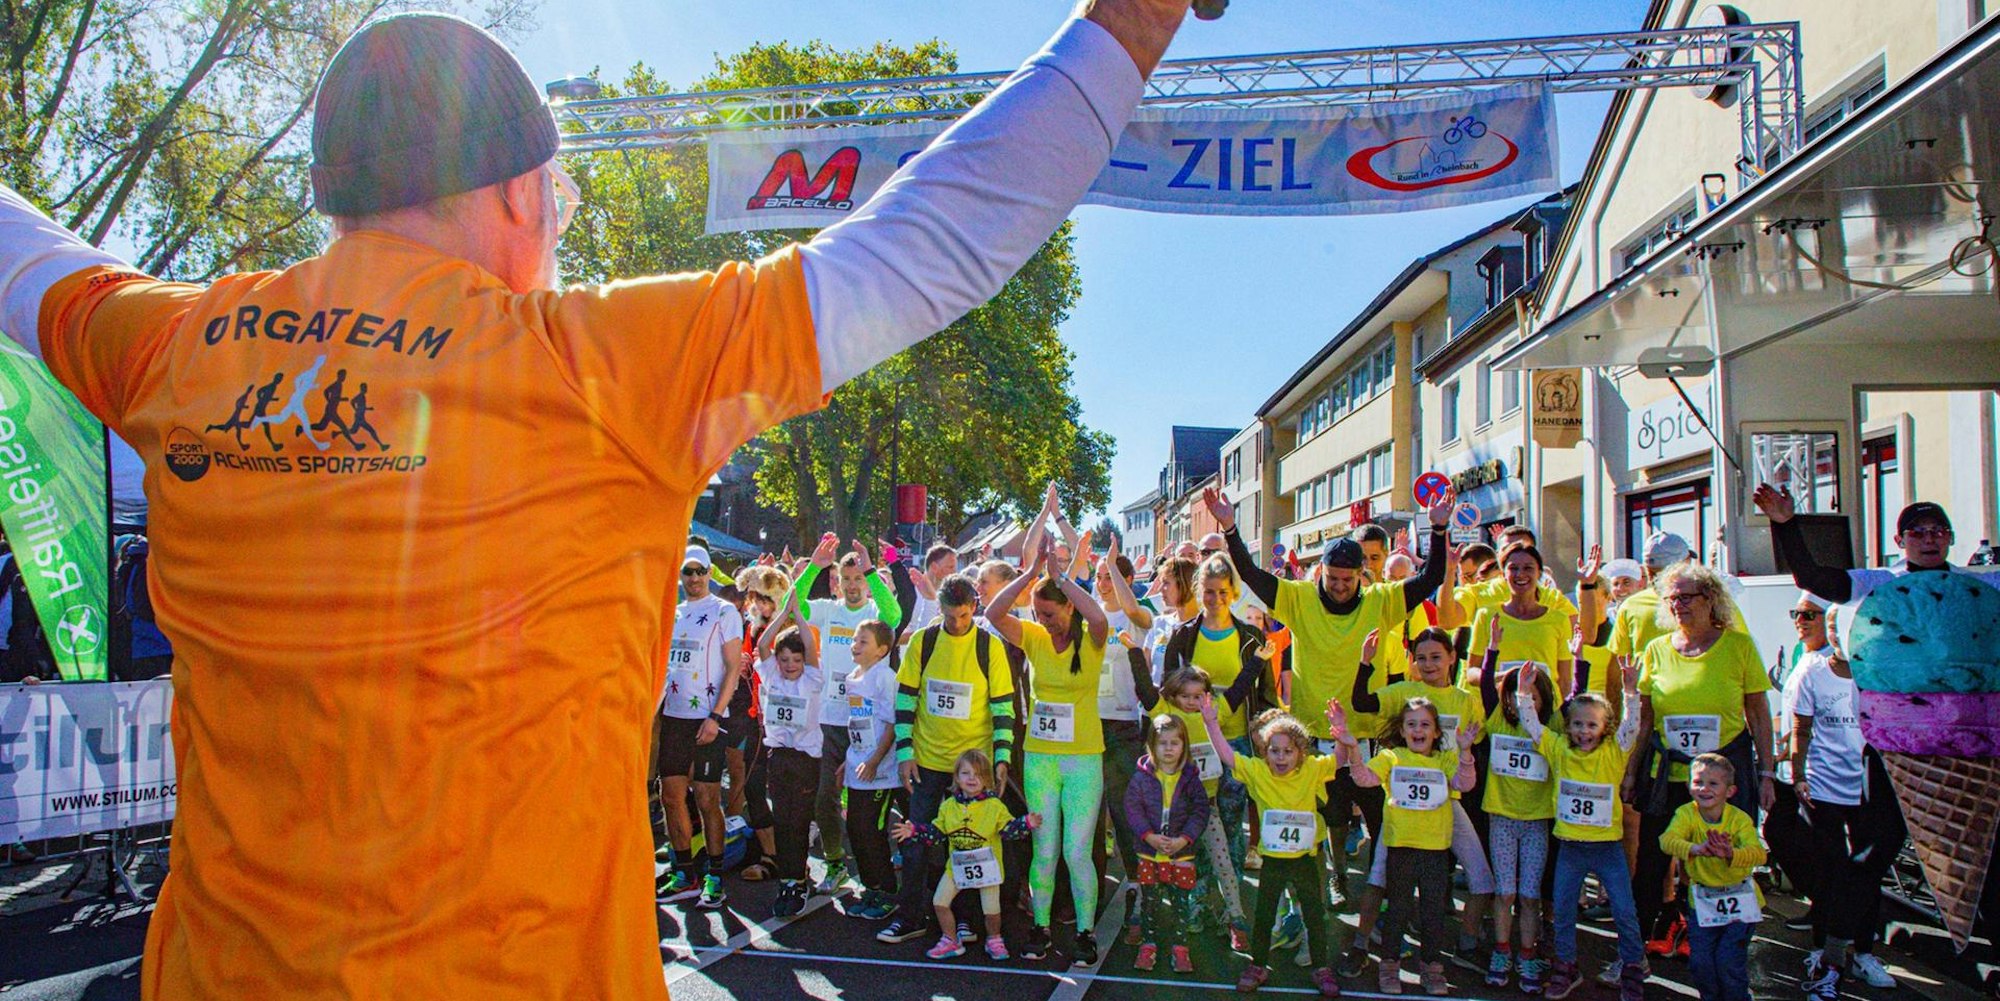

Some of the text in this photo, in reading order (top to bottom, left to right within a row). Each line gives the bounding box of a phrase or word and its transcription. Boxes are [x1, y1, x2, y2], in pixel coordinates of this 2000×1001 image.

[1167, 138, 1313, 192] ZIEL
[1397, 163, 1479, 182] Rund in Rheinbach
[204, 305, 454, 359] ORGATEAM
[1533, 417, 1583, 425] HANEDAN
[170, 443, 204, 453] SPORT
[174, 455, 204, 465] 2000
[214, 452, 427, 473] ACHIMS SPORTSHOP
[670, 650, 691, 663] 118
[937, 695, 955, 710] 55
[777, 707, 793, 721] 93
[1039, 717, 1057, 732] 54
[1680, 732, 1701, 747] 37
[1509, 753, 1531, 769] 50
[1408, 784, 1430, 800] 39
[1571, 799, 1594, 815] 38
[1279, 827, 1300, 843] 44
[964, 865, 983, 880] 53
[1716, 897, 1741, 915] 42
